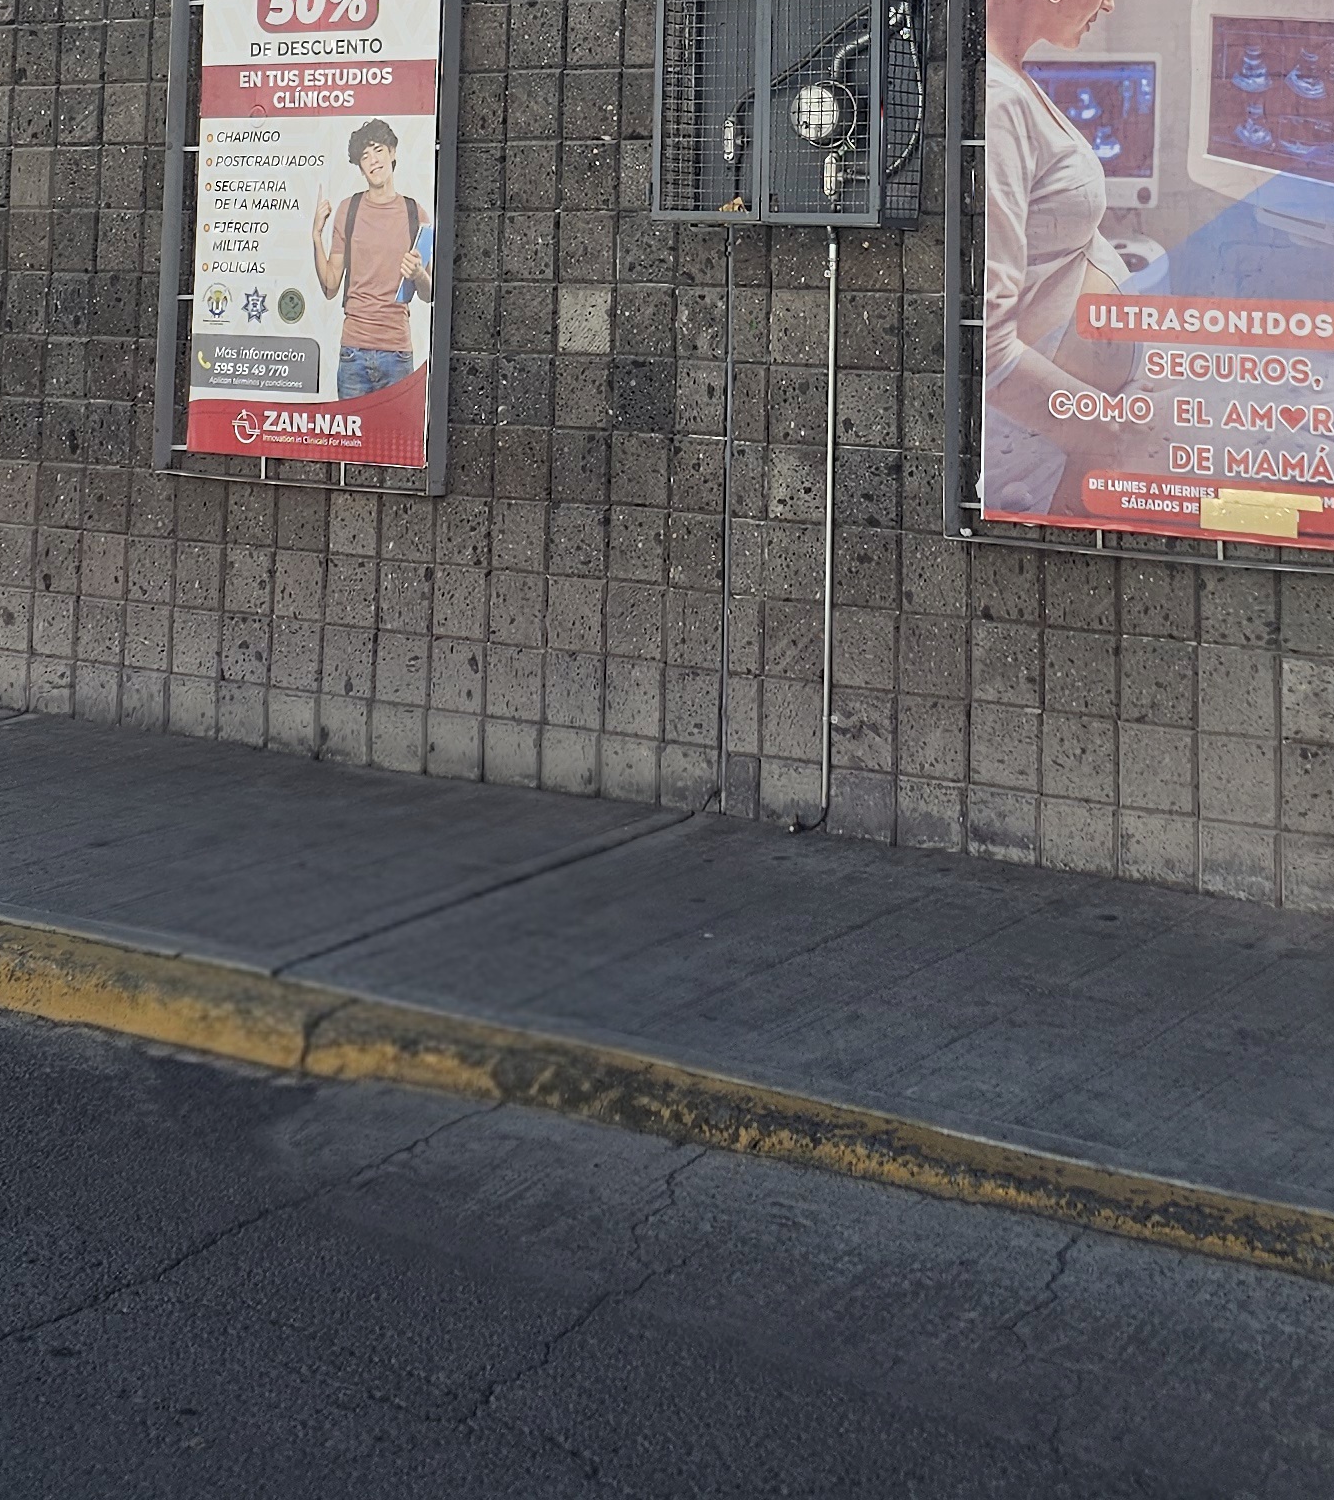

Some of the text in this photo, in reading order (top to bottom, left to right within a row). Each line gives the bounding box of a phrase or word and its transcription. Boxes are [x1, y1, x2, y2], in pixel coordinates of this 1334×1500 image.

[250, 38, 383, 57] DE DESCUENTO
[239, 67, 393, 88] EN TUS ESTUDIOS
[273, 88, 354, 108] CLÍNICOS
[216, 130, 280, 143] CHAPINGO
[215, 155, 325, 168] POSTGRADUADOS
[214, 180, 287, 193] SECRETARIA
[214, 198, 300, 211] DE LA MARINA
[212, 240, 259, 252] MILITAR
[1088, 305, 1334, 338] ULTRASONIDOS
[213, 362, 289, 377] 595 95 49 770
[1145, 350, 1324, 391] SEGUROS,
[1049, 390, 1154, 424] COMO
[1174, 398, 1212, 427] EL
[262, 410, 363, 436] ZAN-NAR
[263, 433, 294, 443] Innovation
[303, 436, 328, 445] Clinicals
[329, 438, 339, 446] For
[340, 439, 362, 447] Health
[1169, 443, 1213, 474] DE
[1088, 478, 1105, 490] DE
[1107, 479, 1147, 494] LUNES
[1149, 482, 1159, 495] A
[1161, 483, 1215, 499] VIERNES
[1121, 496, 1199, 514] SÁBADOS DE
